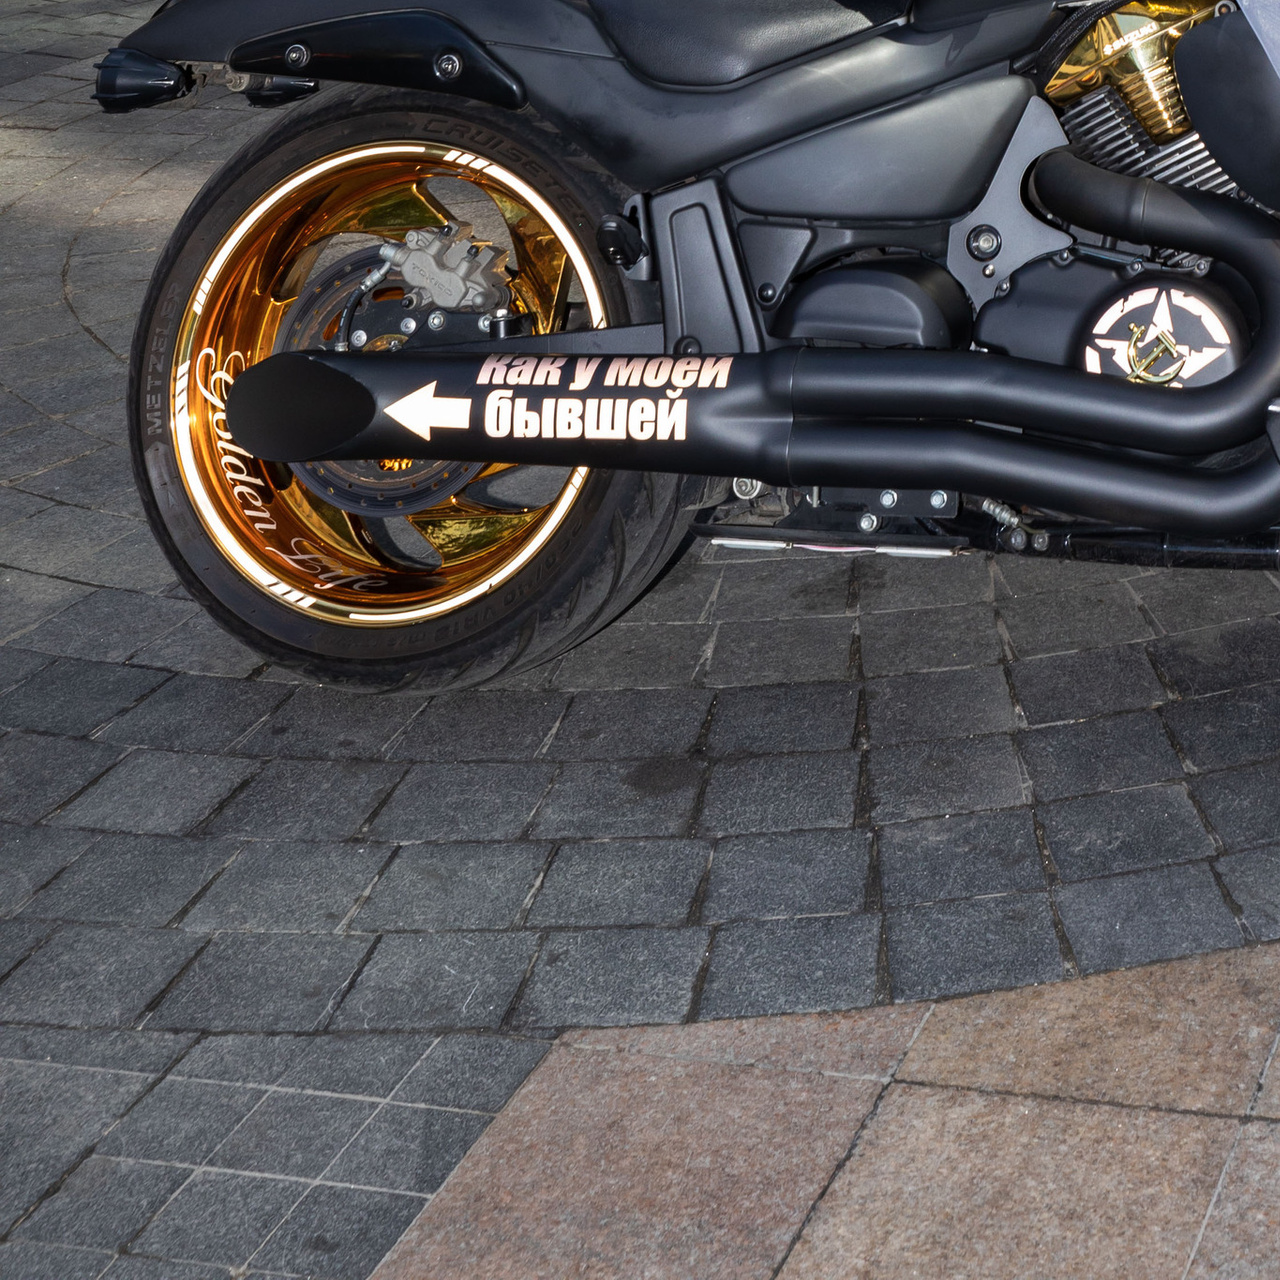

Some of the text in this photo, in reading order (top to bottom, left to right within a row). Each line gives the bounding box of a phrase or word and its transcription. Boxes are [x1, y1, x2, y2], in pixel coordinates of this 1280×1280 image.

[147, 280, 183, 440] METZELER
[476, 352, 568, 386] Как
[568, 356, 604, 391] у
[484, 387, 689, 441] бывшей
[265, 537, 389, 590] Life
